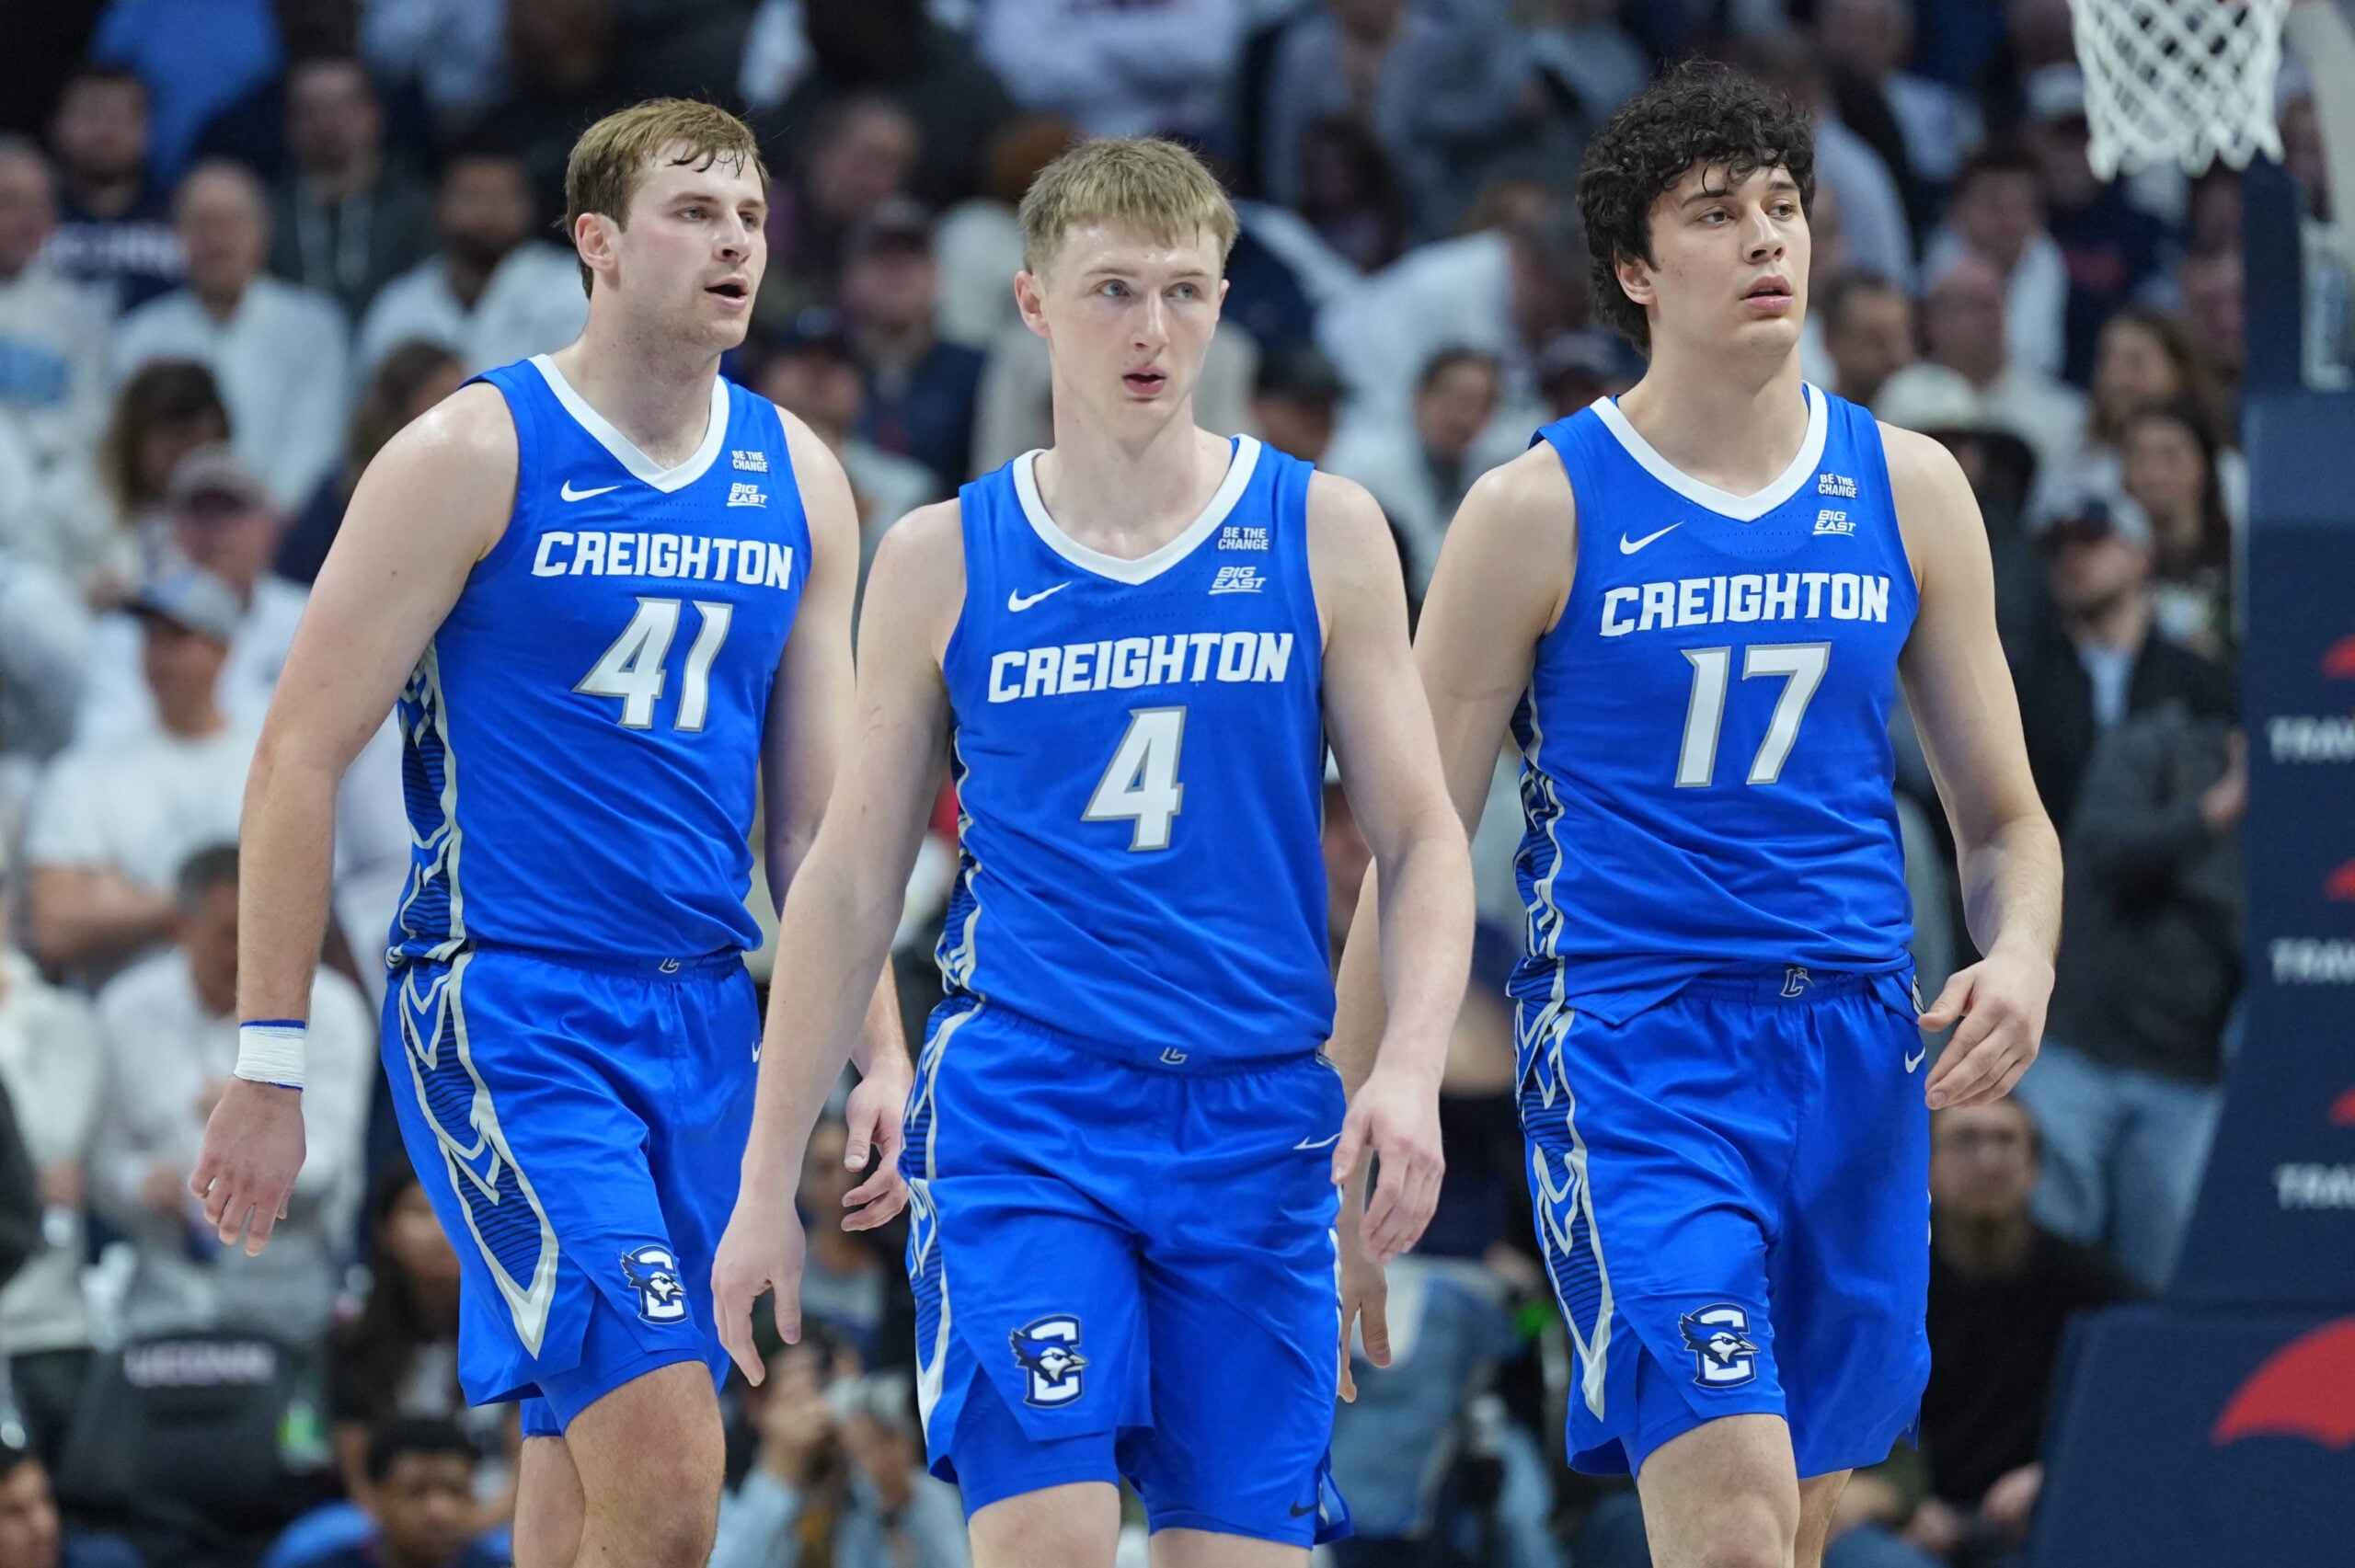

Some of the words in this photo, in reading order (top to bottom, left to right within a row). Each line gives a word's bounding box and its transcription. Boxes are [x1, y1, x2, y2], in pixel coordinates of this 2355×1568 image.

[731, 450, 746, 460] BE
[745, 451, 764, 461] THE
[732, 459, 768, 473] CHANGE
[1820, 473, 1834, 484] BE
[1835, 475, 1855, 486] THE
[730, 482, 758, 494] BIG
[1818, 483, 1857, 498] CHANGE
[728, 492, 768, 505] EAST
[1817, 509, 1847, 521] BIG
[1222, 526, 1240, 539] BE
[1242, 527, 1267, 539] THE
[1814, 520, 1856, 532] EAST
[1217, 538, 1269, 550] CHANGE
[531, 531, 794, 589] CREIGHTON
[1216, 566, 1257, 578] BIG
[1211, 577, 1267, 589] EAST
[1599, 572, 1890, 637] CREIGHTON
[570, 596, 734, 733] 41
[987, 631, 1294, 704] CREIGHTON
[1674, 641, 1832, 788] 17
[1079, 705, 1188, 853] 4
